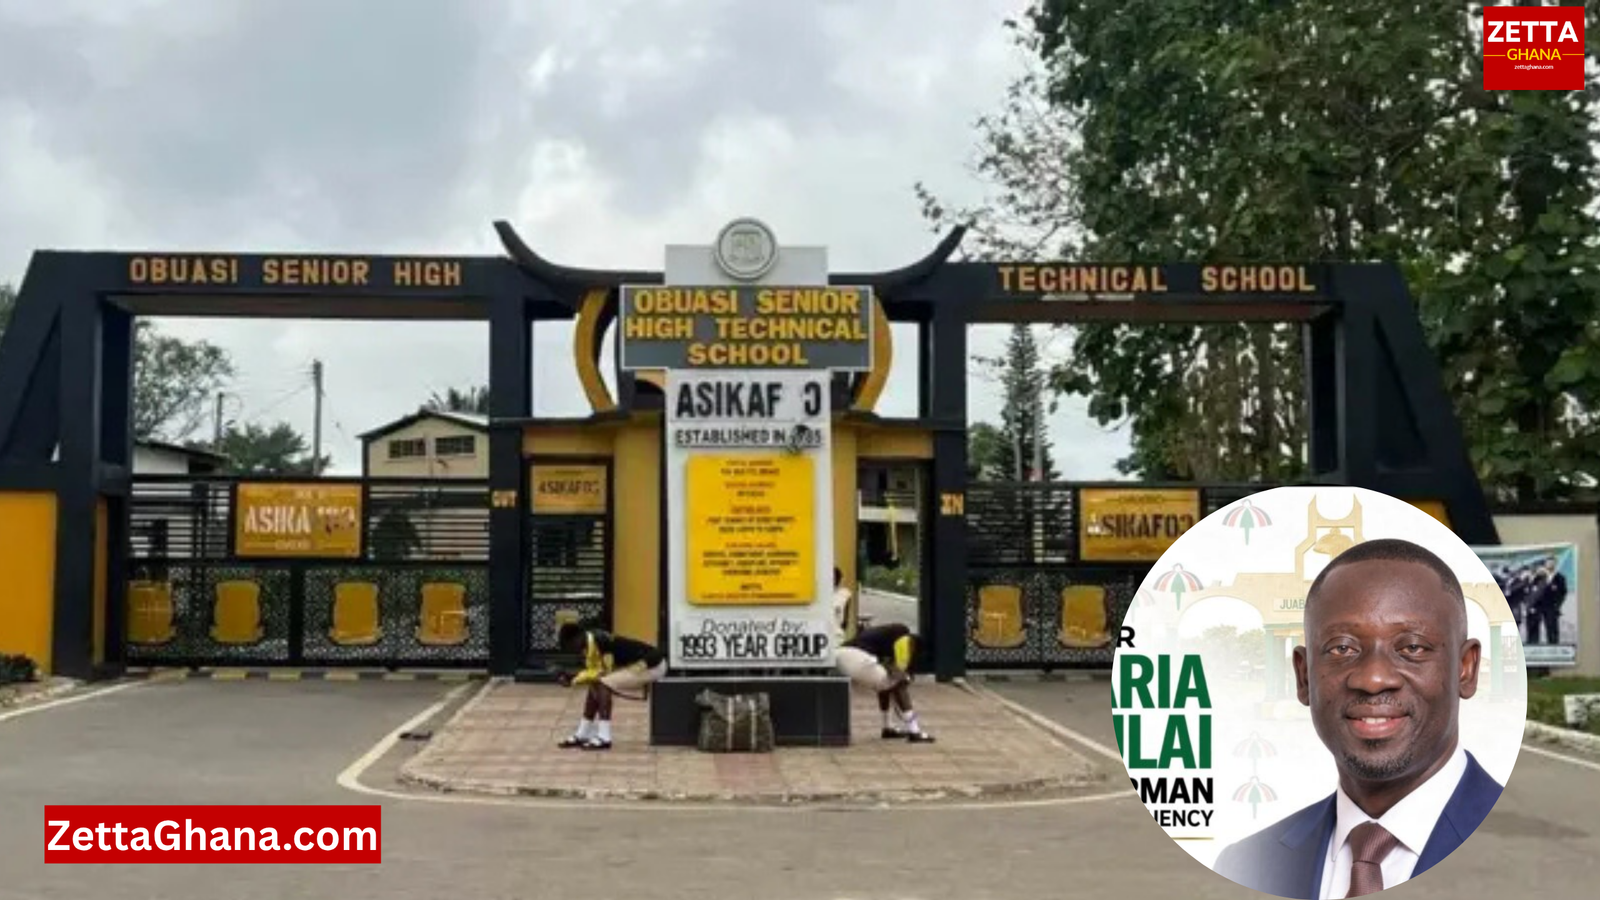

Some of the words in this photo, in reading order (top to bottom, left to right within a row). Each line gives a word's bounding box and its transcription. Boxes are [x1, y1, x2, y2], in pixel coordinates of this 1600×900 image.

[129, 258, 238, 283] OBUASI
[262, 260, 369, 285] SENIOR
[393, 262, 462, 286] HIGH
[998, 267, 1168, 292] TECHNICAL
[1202, 267, 1316, 292] SCHOOL
[634, 289, 738, 314] OBUASI
[756, 289, 860, 314] SENIOR
[626, 317, 694, 338] HIGH
[716, 317, 867, 339] TECHNICAL
[688, 344, 809, 365] SCHOOL
[675, 429, 769, 444] ESTABLISHED
[702, 618, 776, 634] Donated
[680, 633, 717, 658] 1993
[723, 633, 768, 658] YEAR
[774, 633, 828, 658] GROUP
